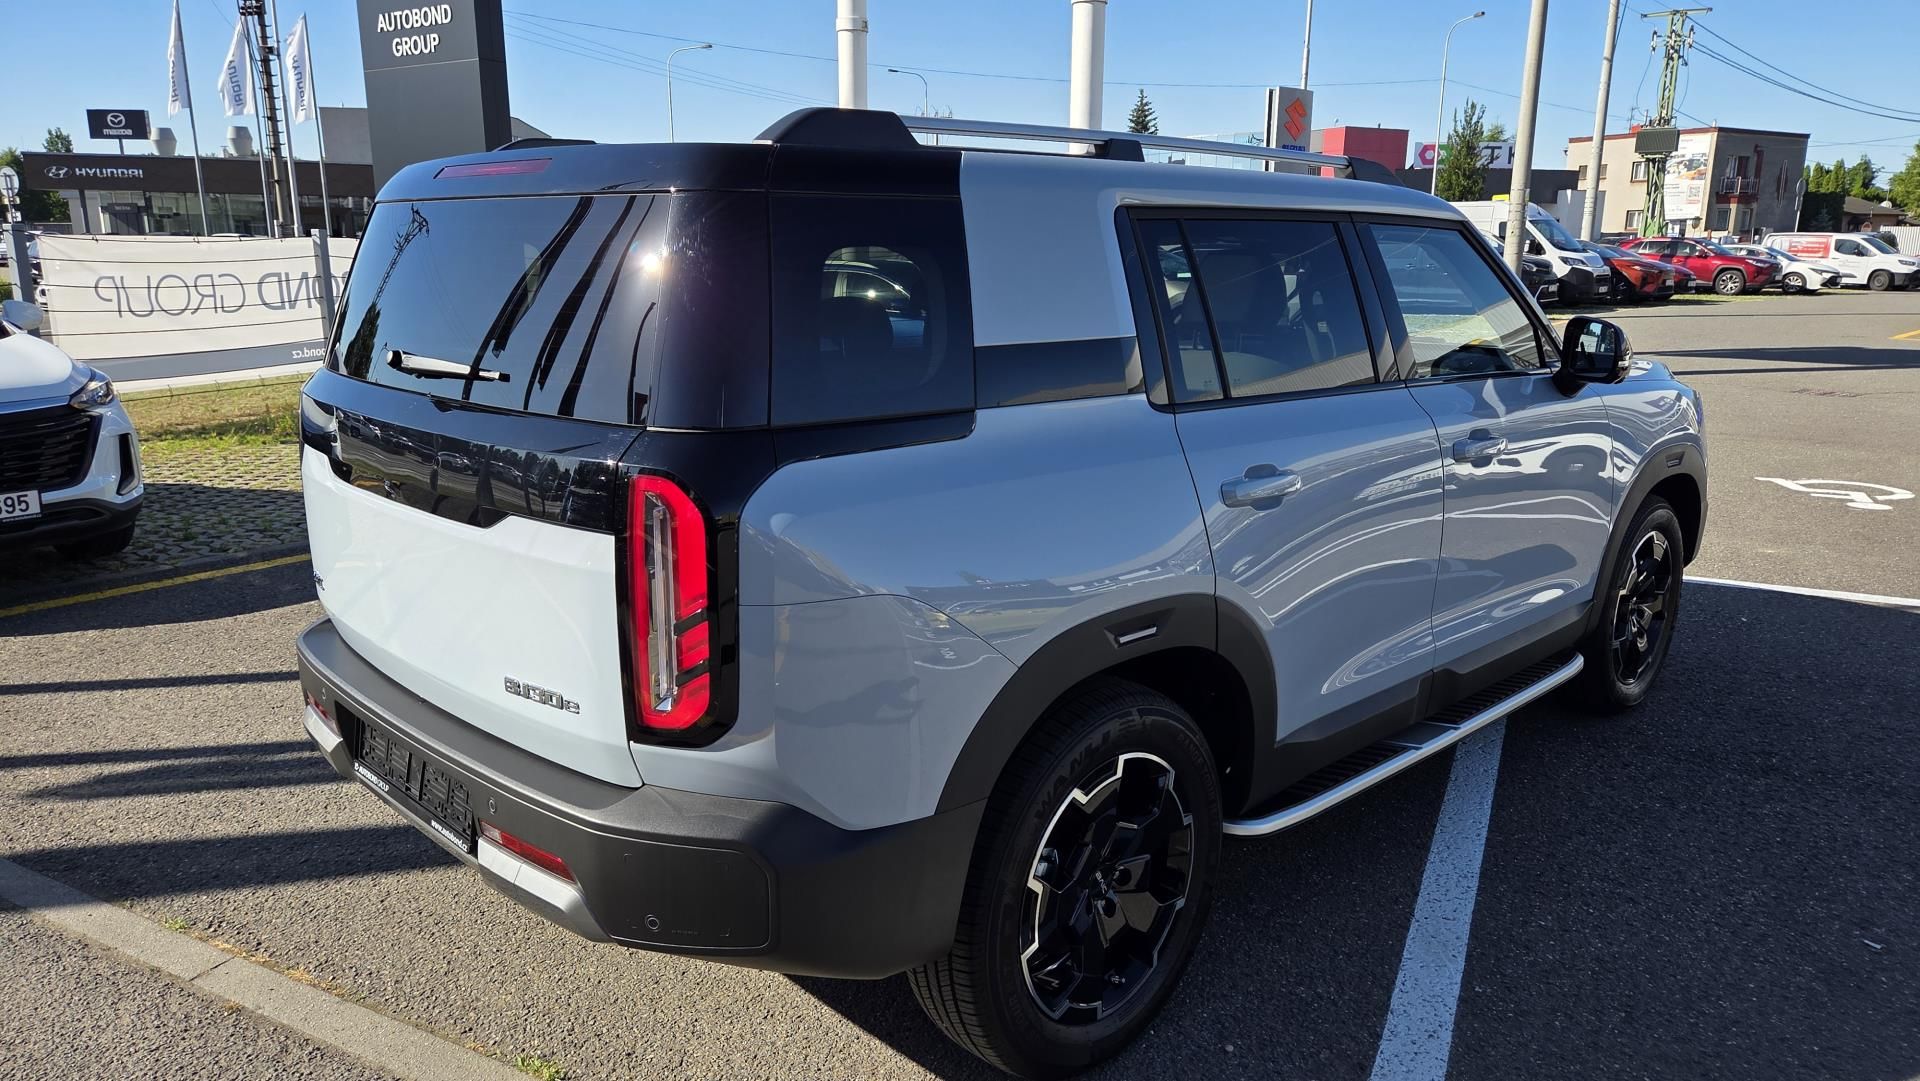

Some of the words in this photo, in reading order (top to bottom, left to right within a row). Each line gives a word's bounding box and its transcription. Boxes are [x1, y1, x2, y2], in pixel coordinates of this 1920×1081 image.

[377, 4, 452, 33] AUTOBOND
[392, 33, 440, 57] GROUP
[103, 128, 133, 136] mazda
[75, 167, 144, 178] HYUNDAI
[0, 494, 30, 515] 95
